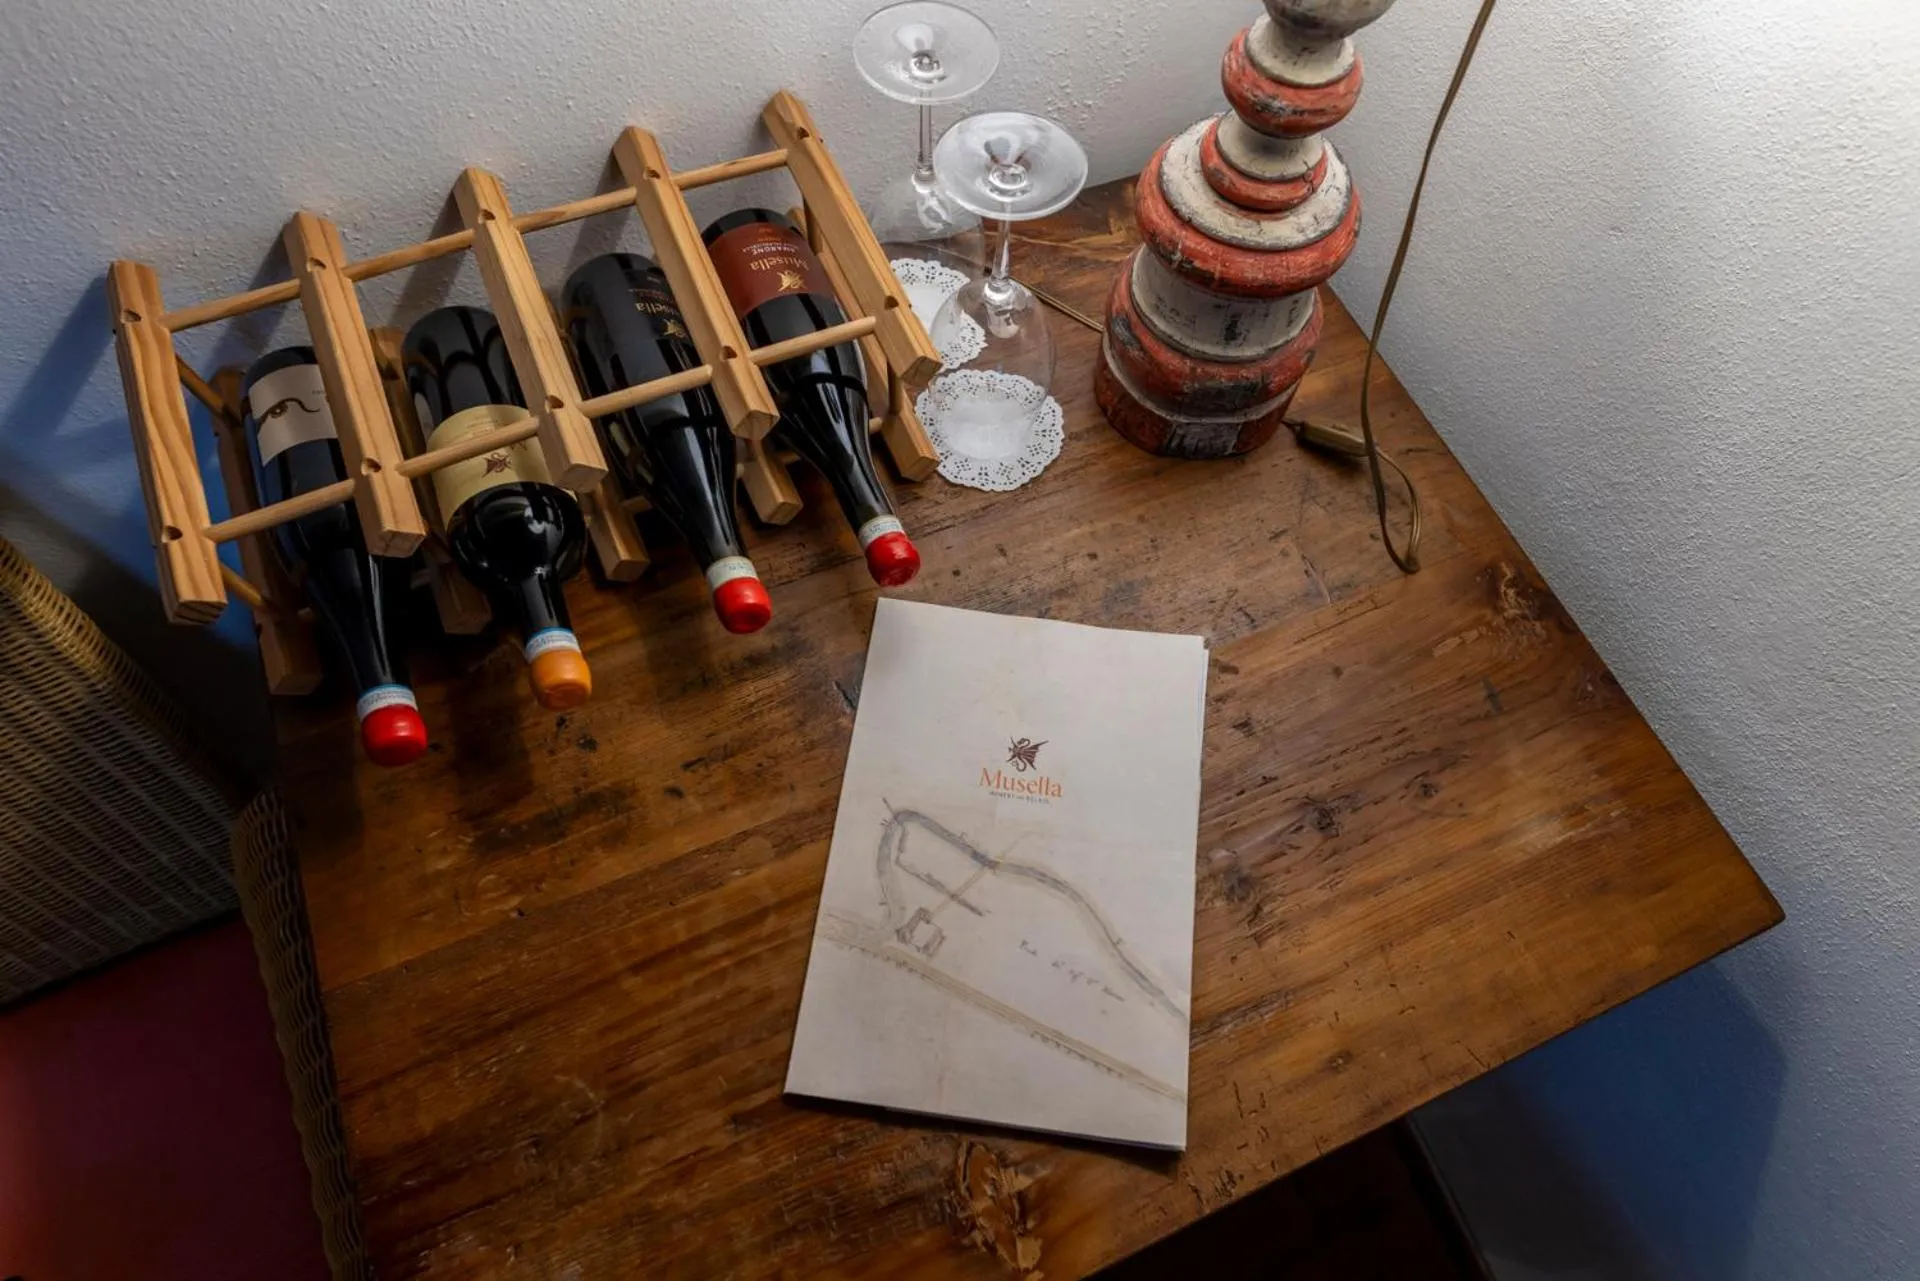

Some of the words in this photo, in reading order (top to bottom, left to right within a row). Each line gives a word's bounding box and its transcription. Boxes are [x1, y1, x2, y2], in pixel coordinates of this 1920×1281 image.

[749, 256, 809, 271] Musella
[635, 302, 680, 317] ella
[979, 767, 1063, 797] Musella
